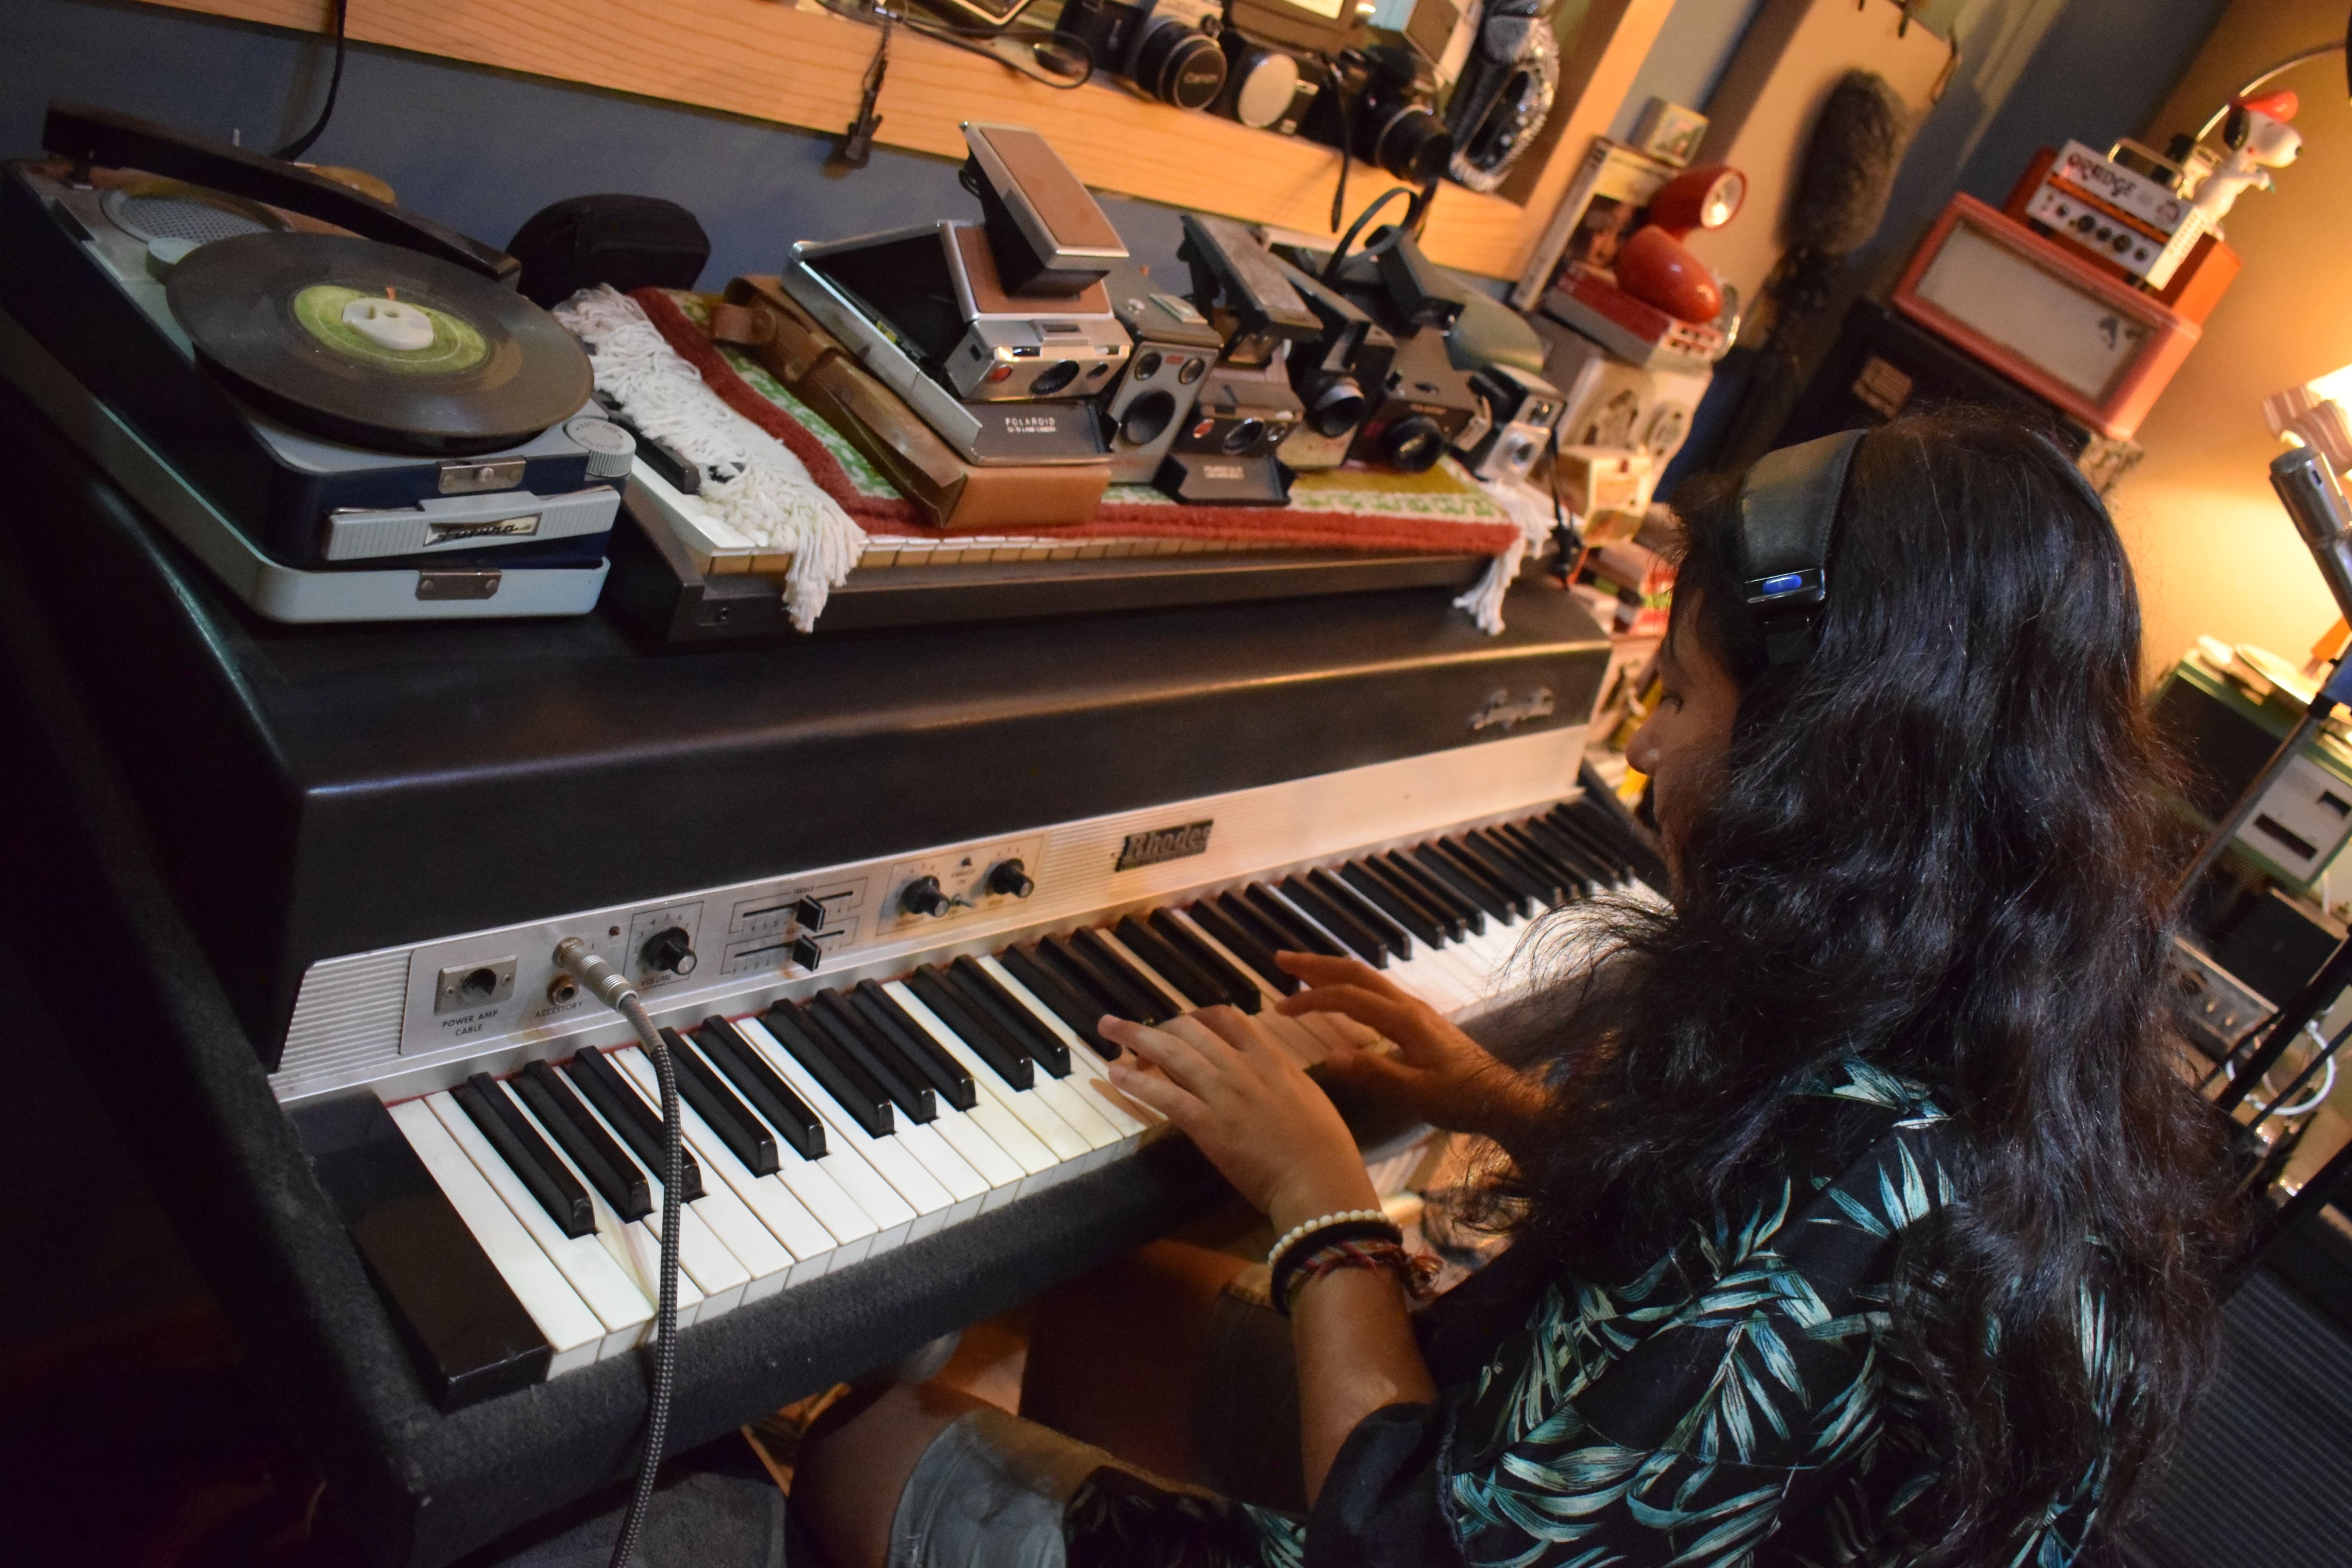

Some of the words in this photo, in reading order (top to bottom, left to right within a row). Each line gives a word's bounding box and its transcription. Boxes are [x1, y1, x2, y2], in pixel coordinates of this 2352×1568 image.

[1005, 417, 1055, 426] POLAROID
[1121, 823, 1212, 860] Rhodes
[535, 1000, 583, 1018] ACCESSORY
[442, 1015, 474, 1028] POWER
[478, 1009, 499, 1020] AMP
[455, 1024, 483, 1036] CABLE
